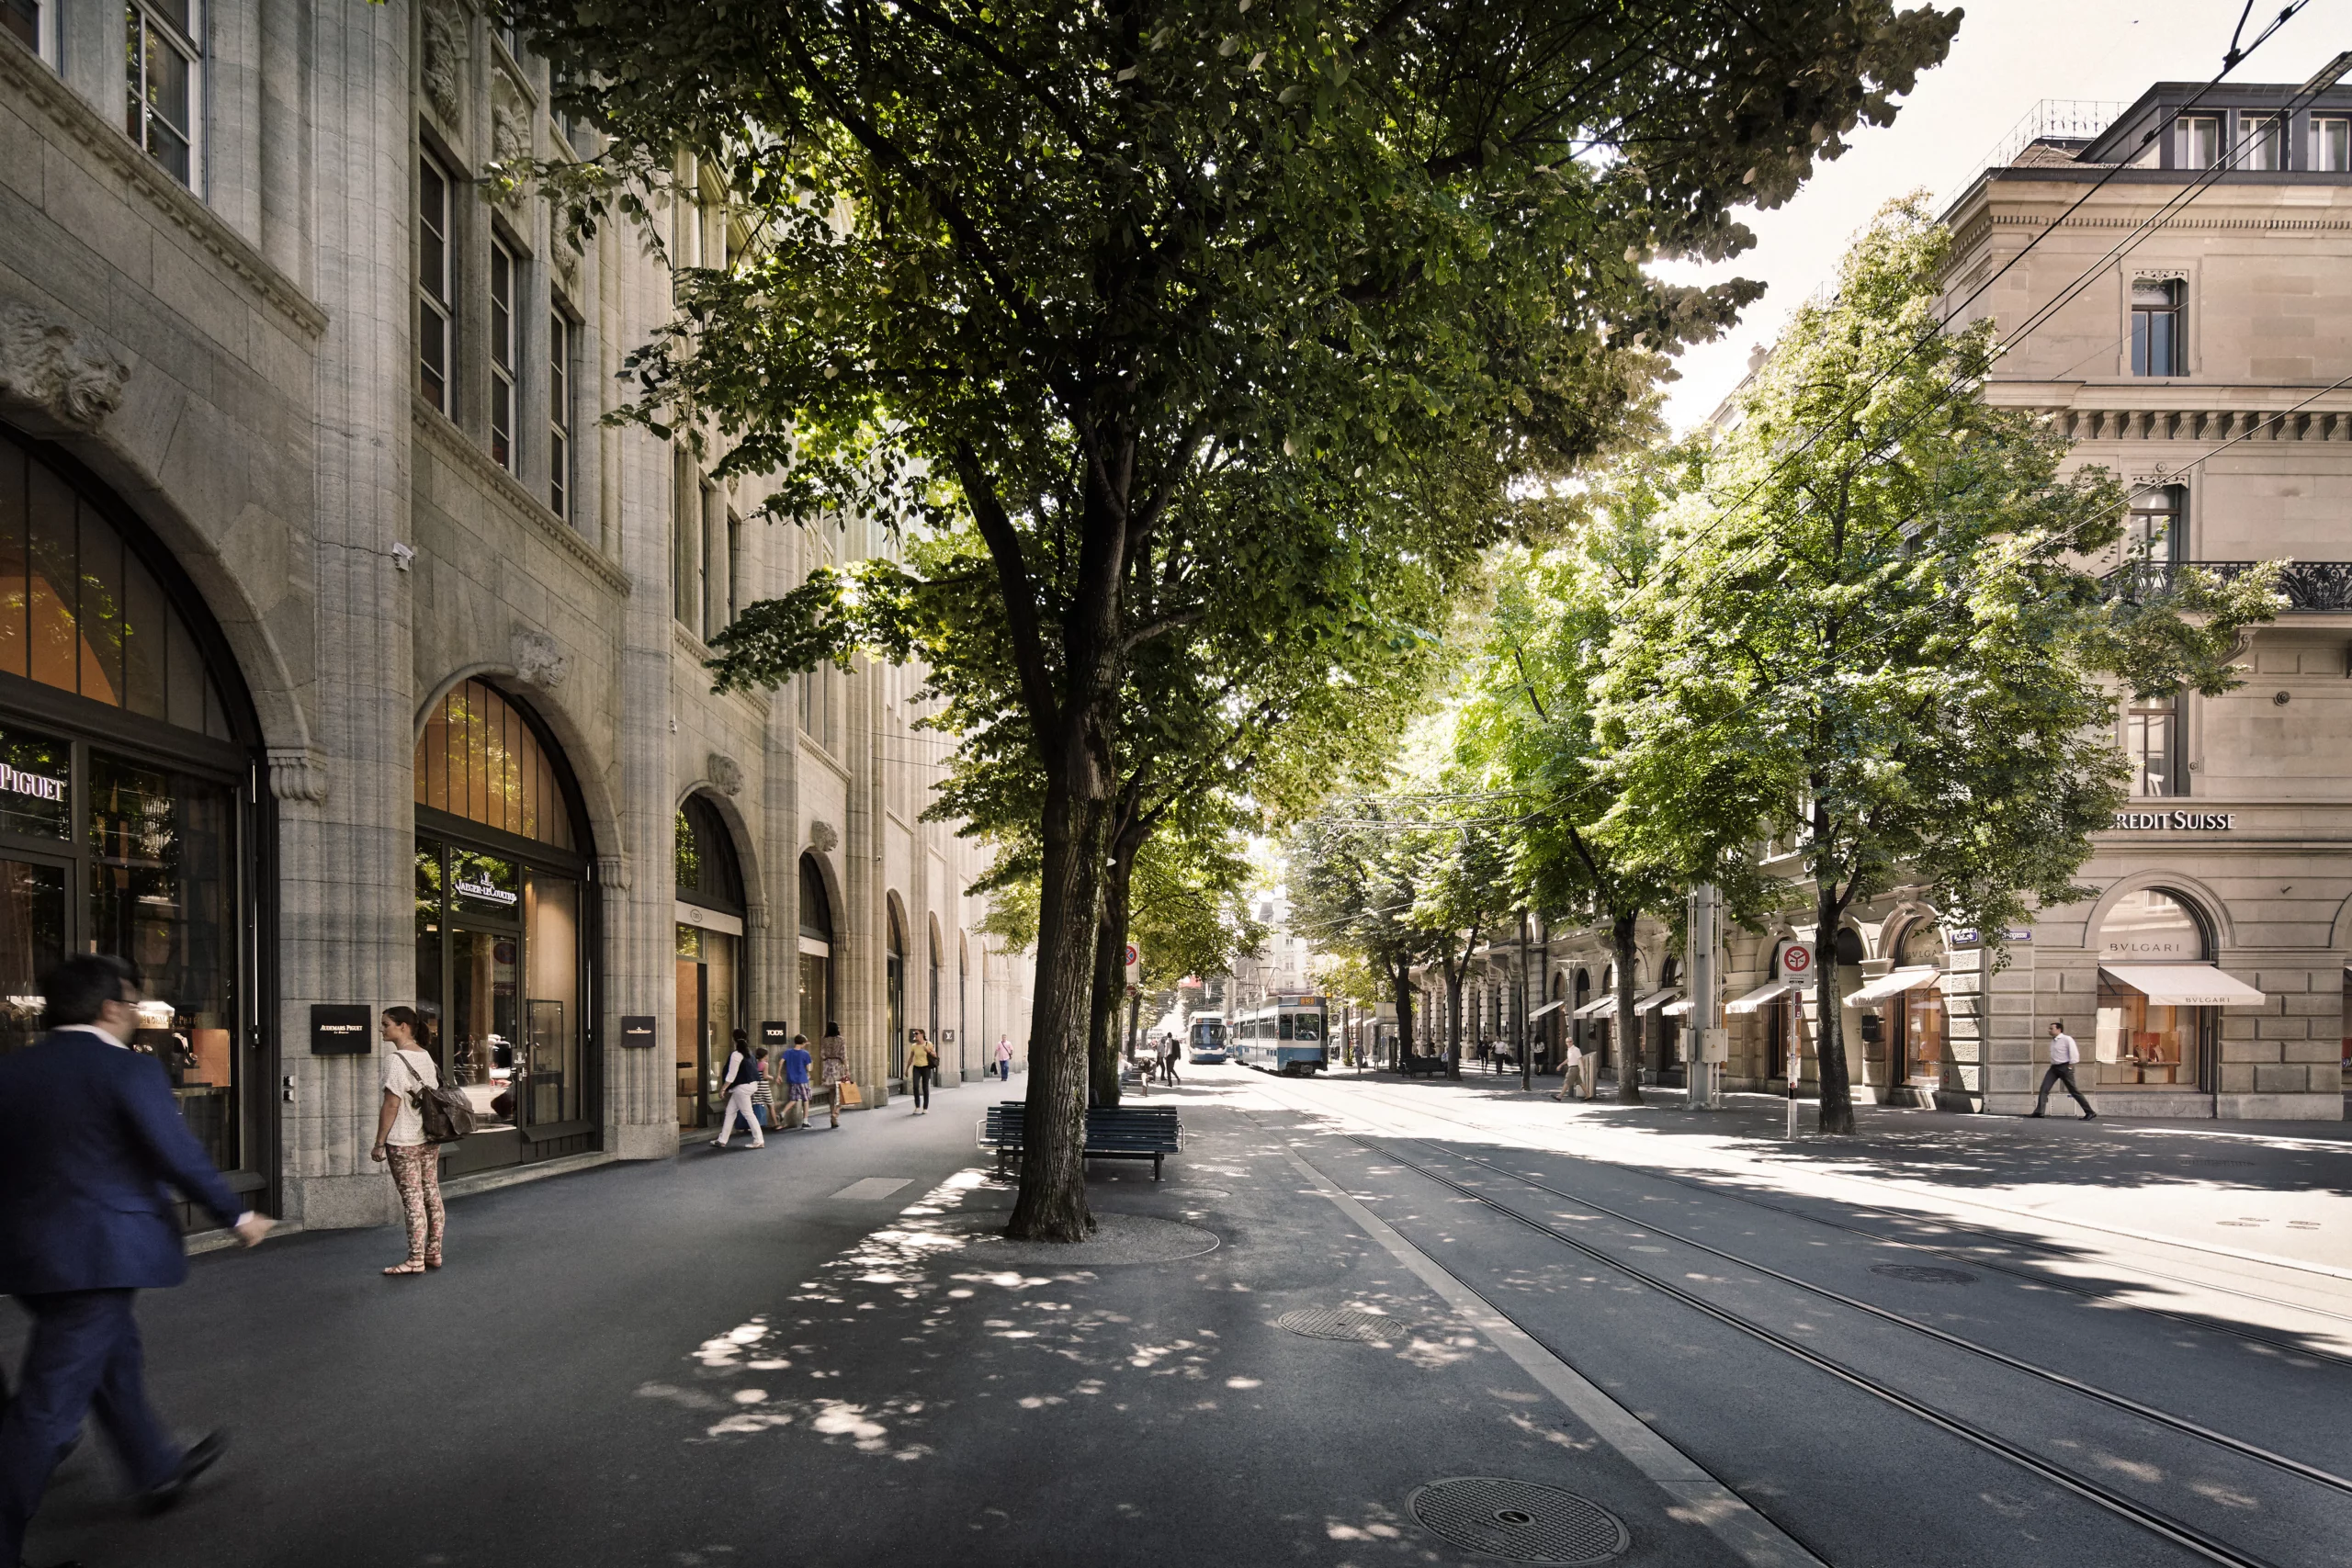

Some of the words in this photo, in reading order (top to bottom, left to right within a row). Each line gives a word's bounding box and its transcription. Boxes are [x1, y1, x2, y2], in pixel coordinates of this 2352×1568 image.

[0, 763, 68, 802] PIGUET
[2174, 810, 2236, 829] SUISSE
[2109, 943, 2179, 952] BVLGARI
